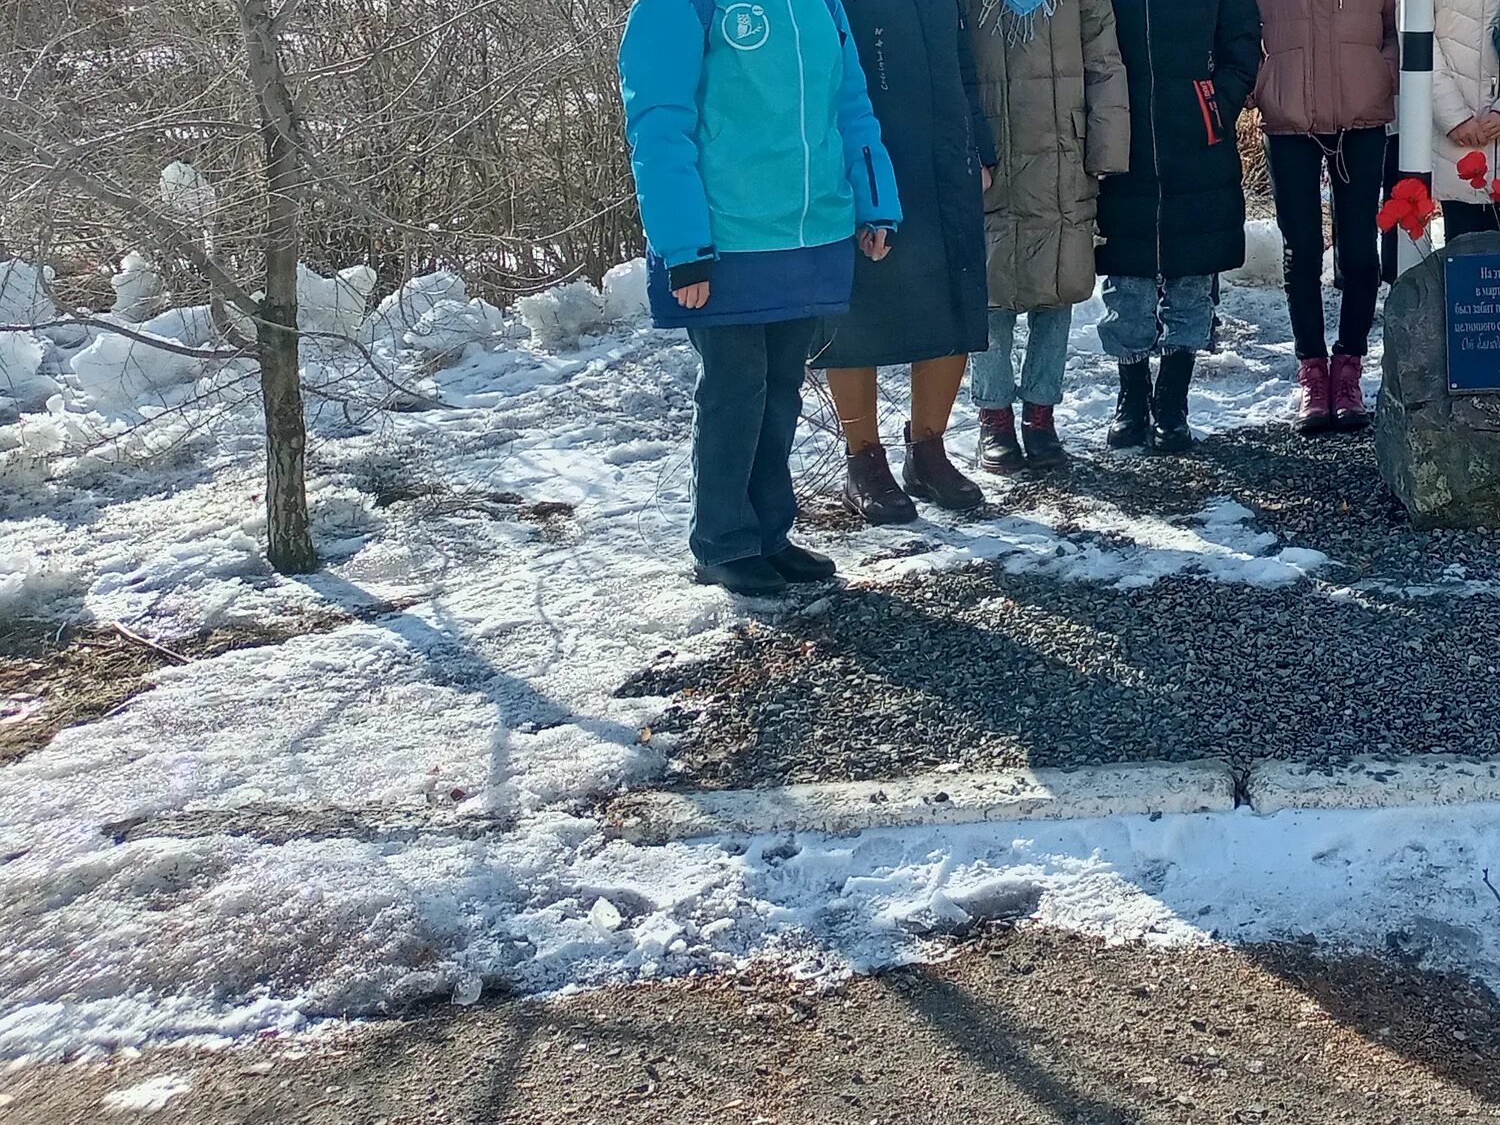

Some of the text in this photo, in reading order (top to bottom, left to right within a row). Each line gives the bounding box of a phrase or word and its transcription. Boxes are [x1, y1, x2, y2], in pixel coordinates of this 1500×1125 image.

[1481, 267, 1492, 279] На
[1475, 287, 1481, 296] в
[1454, 302, 1472, 314] был
[1472, 301, 1494, 314] забит
[1454, 321, 1496, 332] целинного
